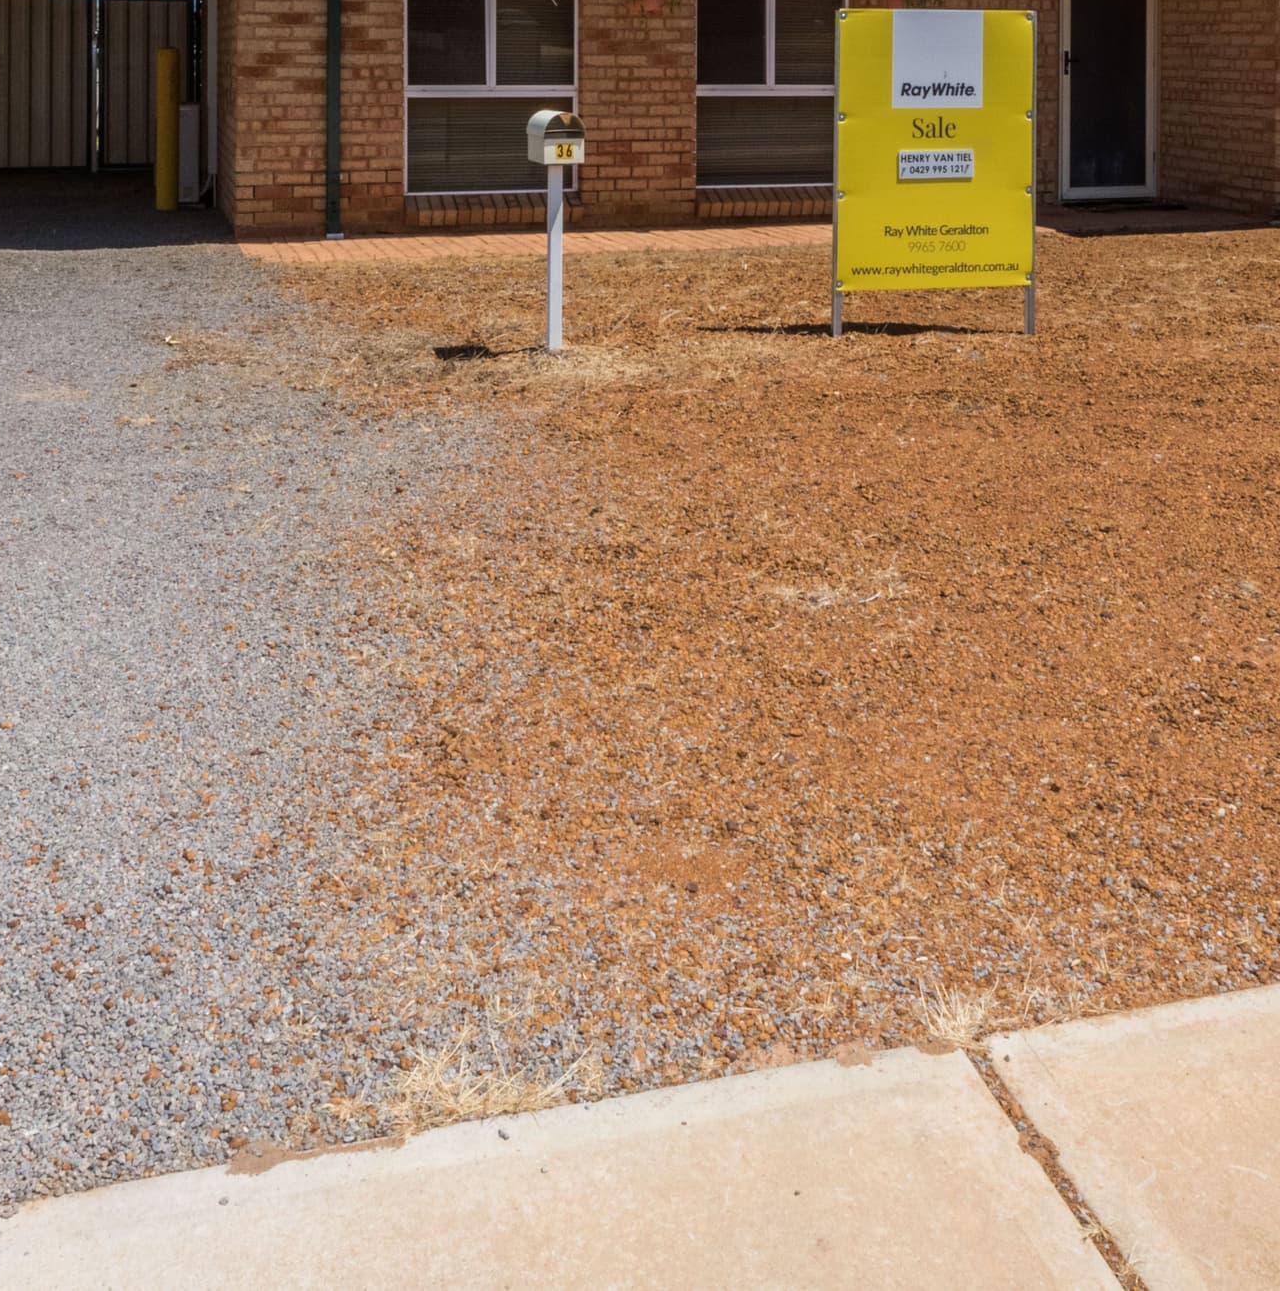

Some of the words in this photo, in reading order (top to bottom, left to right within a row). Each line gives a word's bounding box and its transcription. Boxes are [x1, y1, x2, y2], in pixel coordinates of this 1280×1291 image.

[900, 82, 975, 99] RayWhite
[911, 115, 956, 139] Sale
[556, 143, 573, 158] 36
[900, 153, 930, 164] HENRY
[933, 153, 954, 163] VAN
[956, 152, 972, 162] TIEL
[909, 165, 930, 175] 0429
[932, 165, 948, 174] 995
[884, 225, 903, 238] Ray
[905, 224, 938, 237] White
[939, 224, 989, 236] Geraldton
[908, 241, 936, 253] 9965
[939, 240, 966, 252] 7600
[851, 262, 1019, 276] www.raywhitegeraldton.com.au
